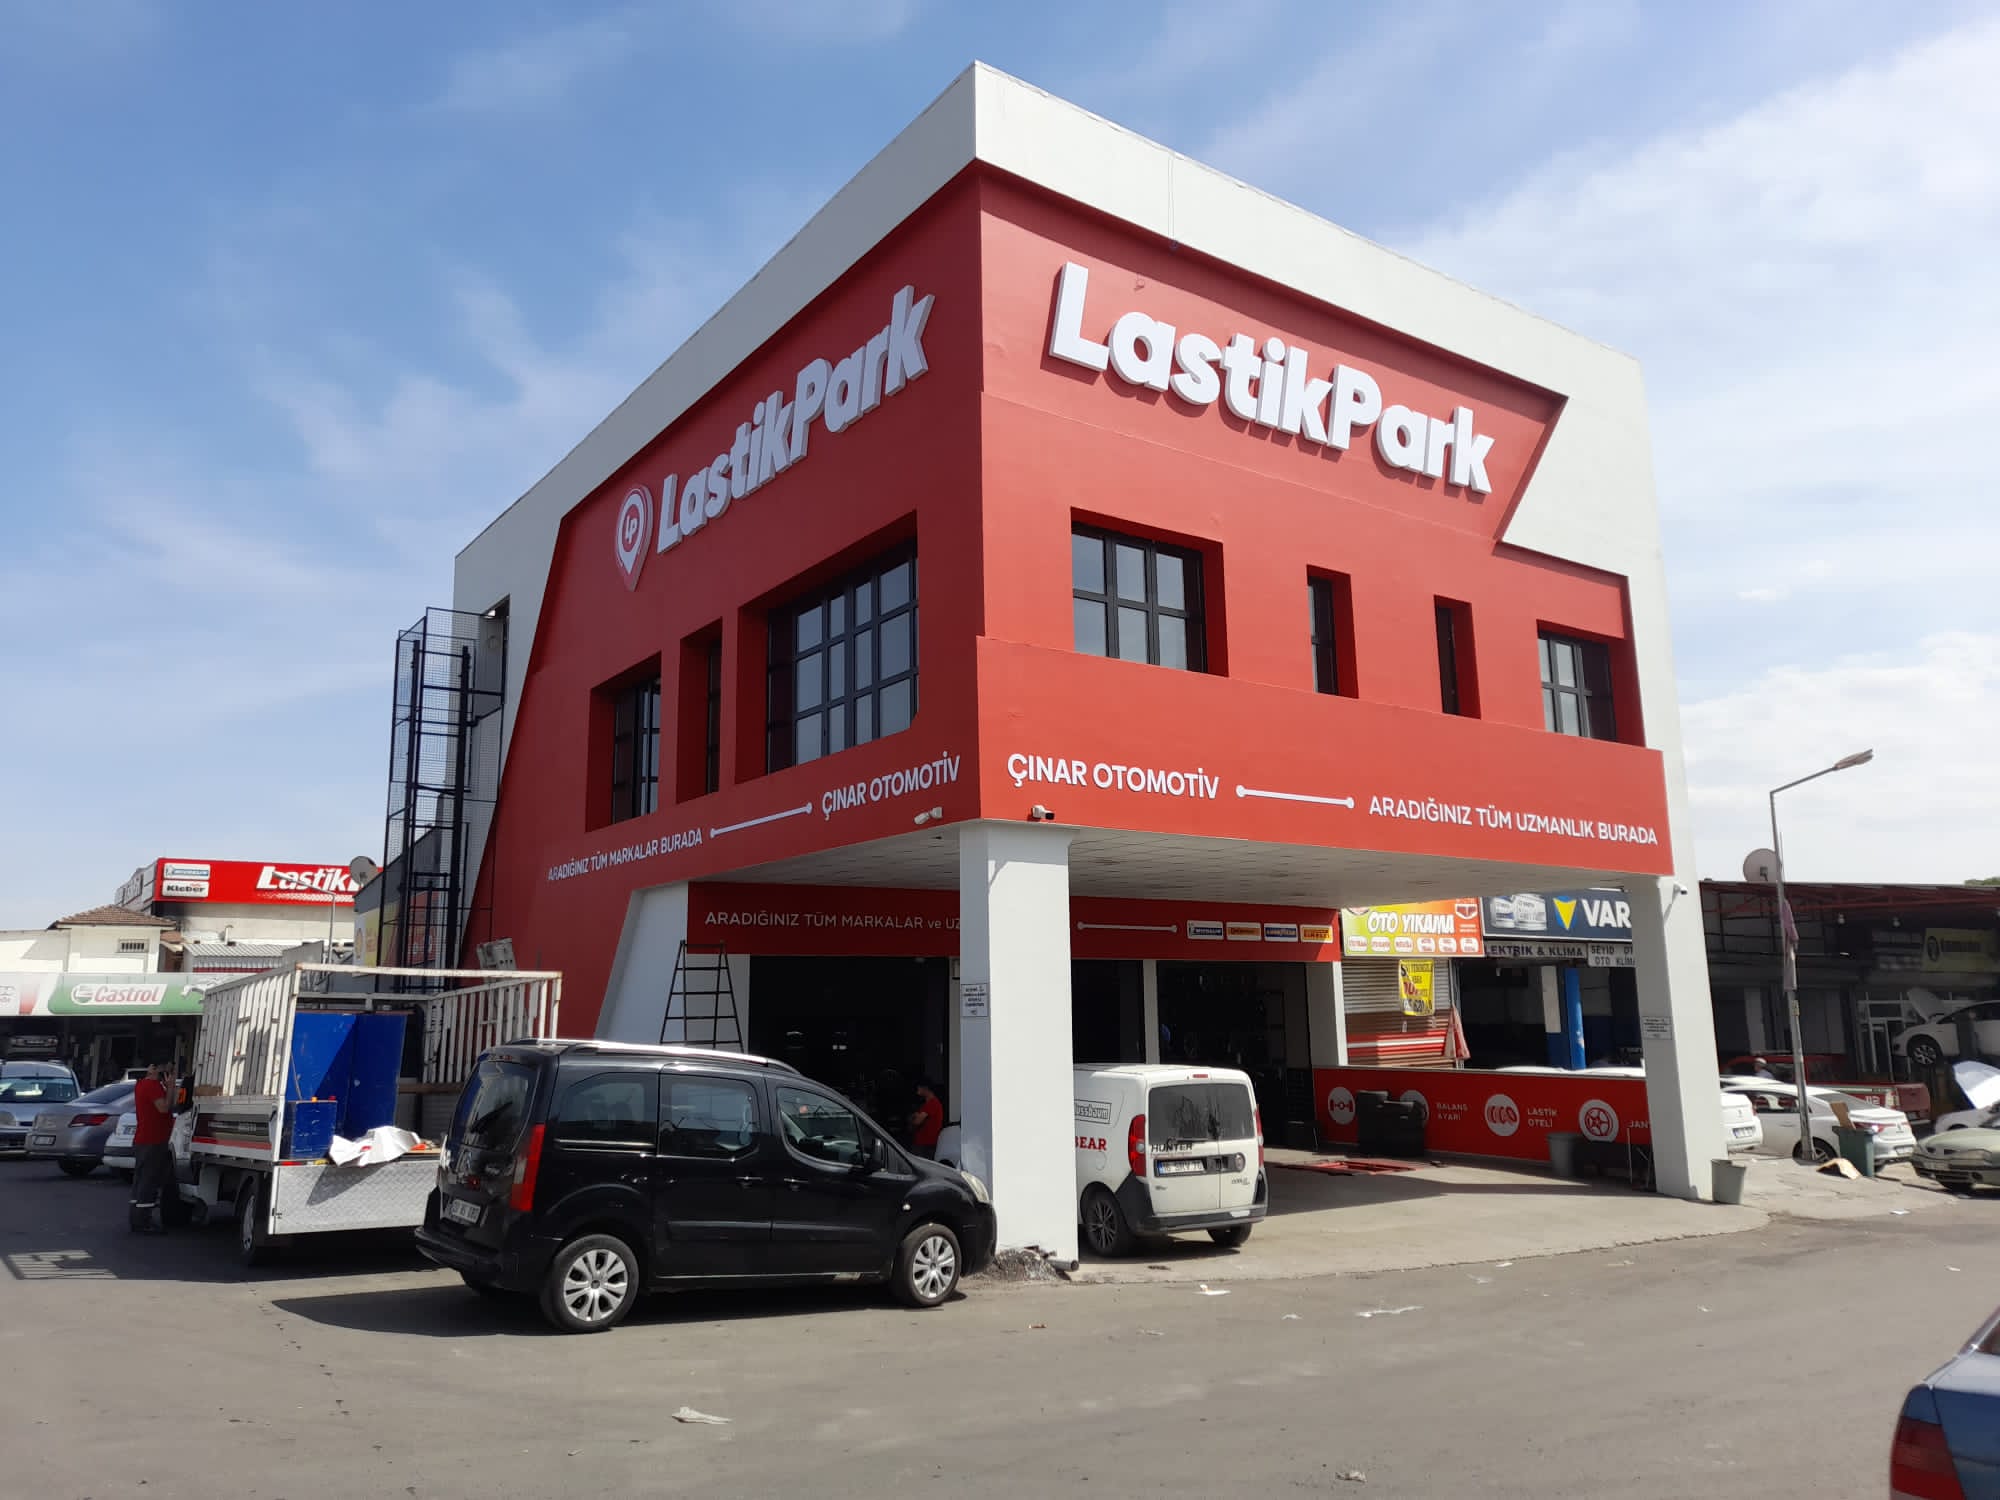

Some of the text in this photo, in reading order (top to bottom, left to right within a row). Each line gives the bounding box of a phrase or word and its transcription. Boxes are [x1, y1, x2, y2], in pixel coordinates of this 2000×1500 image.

[1050, 261, 1495, 495] LastikPark
[656, 285, 935, 555] LastikPark
[822, 751, 961, 821] ÇINAR OTOMOTİV
[1007, 753, 1220, 799] ÇINAR OTOMOTİV
[1369, 796, 1658, 845] ARADIĞINIZ TÜM UZMANLIK BURADA
[547, 827, 703, 881] ARADIĞINIZ TÜM MARKALAR BURADA
[256, 865, 363, 892] Lastik
[704, 910, 800, 927] ARADIĞINIZ
[804, 911, 838, 927] TÜM
[842, 915, 924, 929] MARKALAR
[927, 919, 942, 930] ve
[1367, 910, 1399, 934] OTO
[1401, 913, 1455, 935] YIKAMA
[1582, 899, 1633, 929] VAR
[93, 985, 160, 1004] Castrol
[1151, 1142, 1193, 1153] HUNTER
